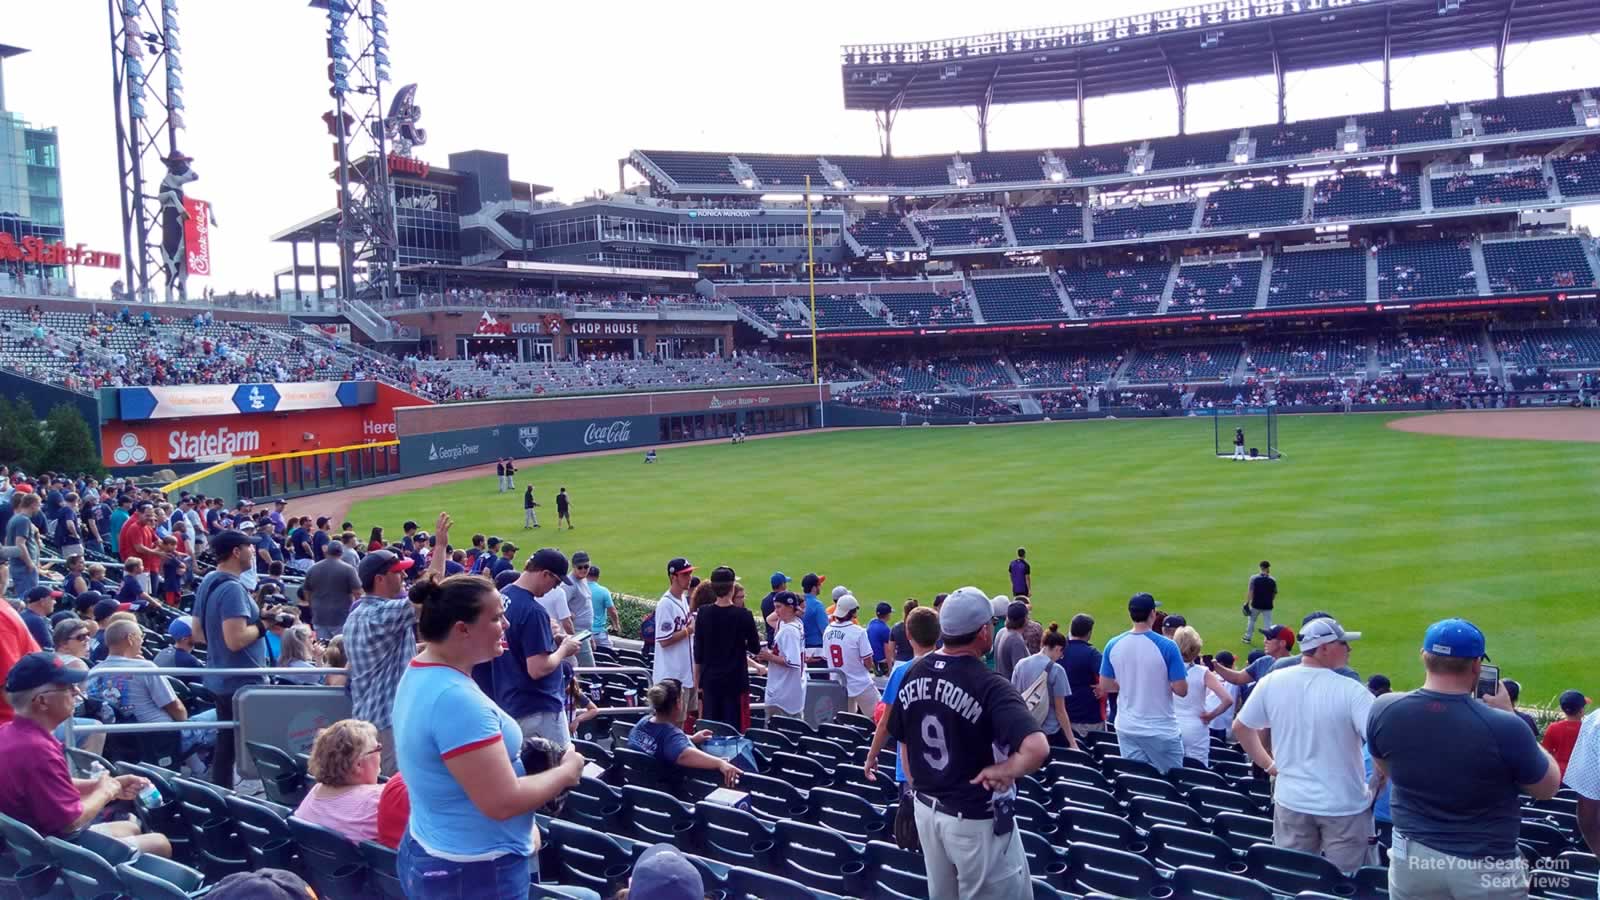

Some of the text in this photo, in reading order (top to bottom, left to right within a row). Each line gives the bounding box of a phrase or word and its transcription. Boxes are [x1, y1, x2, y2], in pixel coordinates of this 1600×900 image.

[698, 209, 751, 217] KONICA MINOLTA
[912, 252, 928, 261] 6:25
[511, 322, 541, 334] LIGHT
[572, 322, 639, 334] CHOP HOUSE
[363, 420, 397, 435] Here
[519, 426, 539, 437] MLB
[438, 443, 480, 460] Georgia Power
[830, 644, 844, 668] 8
[898, 677, 983, 725] STEVE FROMM
[921, 714, 949, 771] 9
